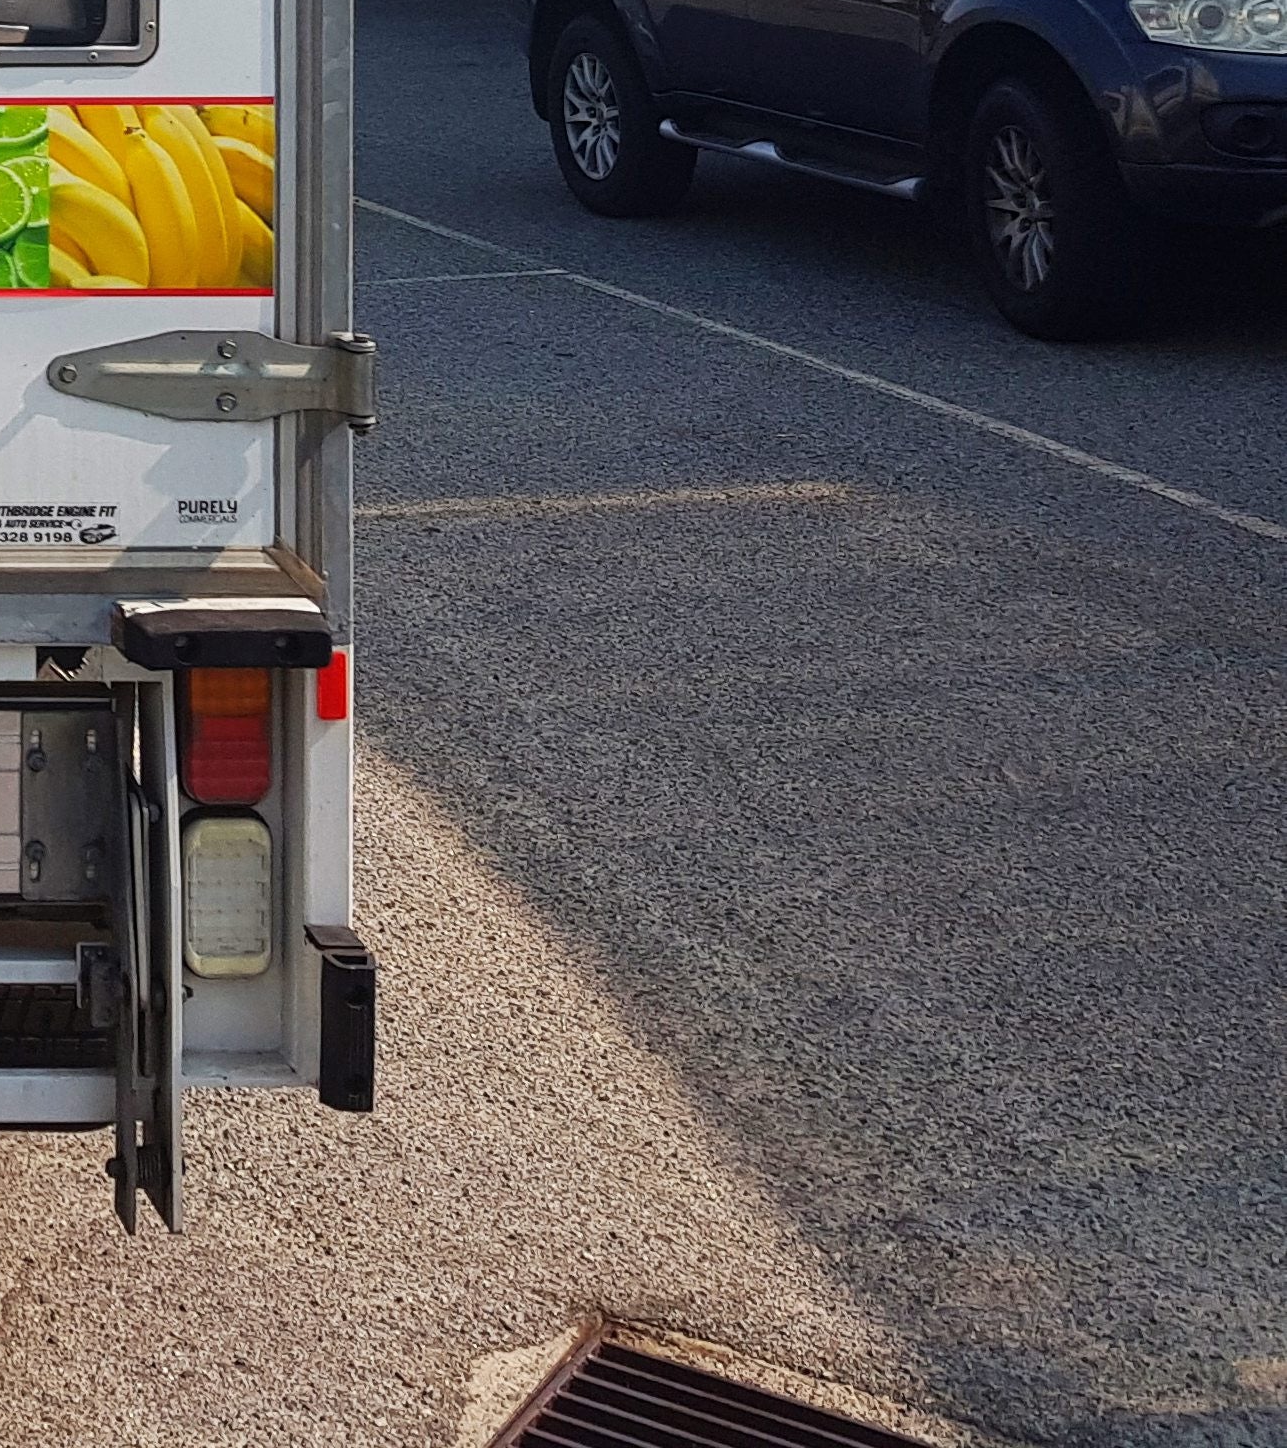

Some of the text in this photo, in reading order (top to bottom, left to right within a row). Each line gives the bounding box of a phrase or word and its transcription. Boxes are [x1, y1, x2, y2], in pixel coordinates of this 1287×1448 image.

[56, 505, 97, 517] ENGINE
[98, 505, 117, 517] FIT
[177, 500, 238, 514] PURELY
[5, 519, 27, 528] AUTO
[33, 531, 73, 543] 9198
